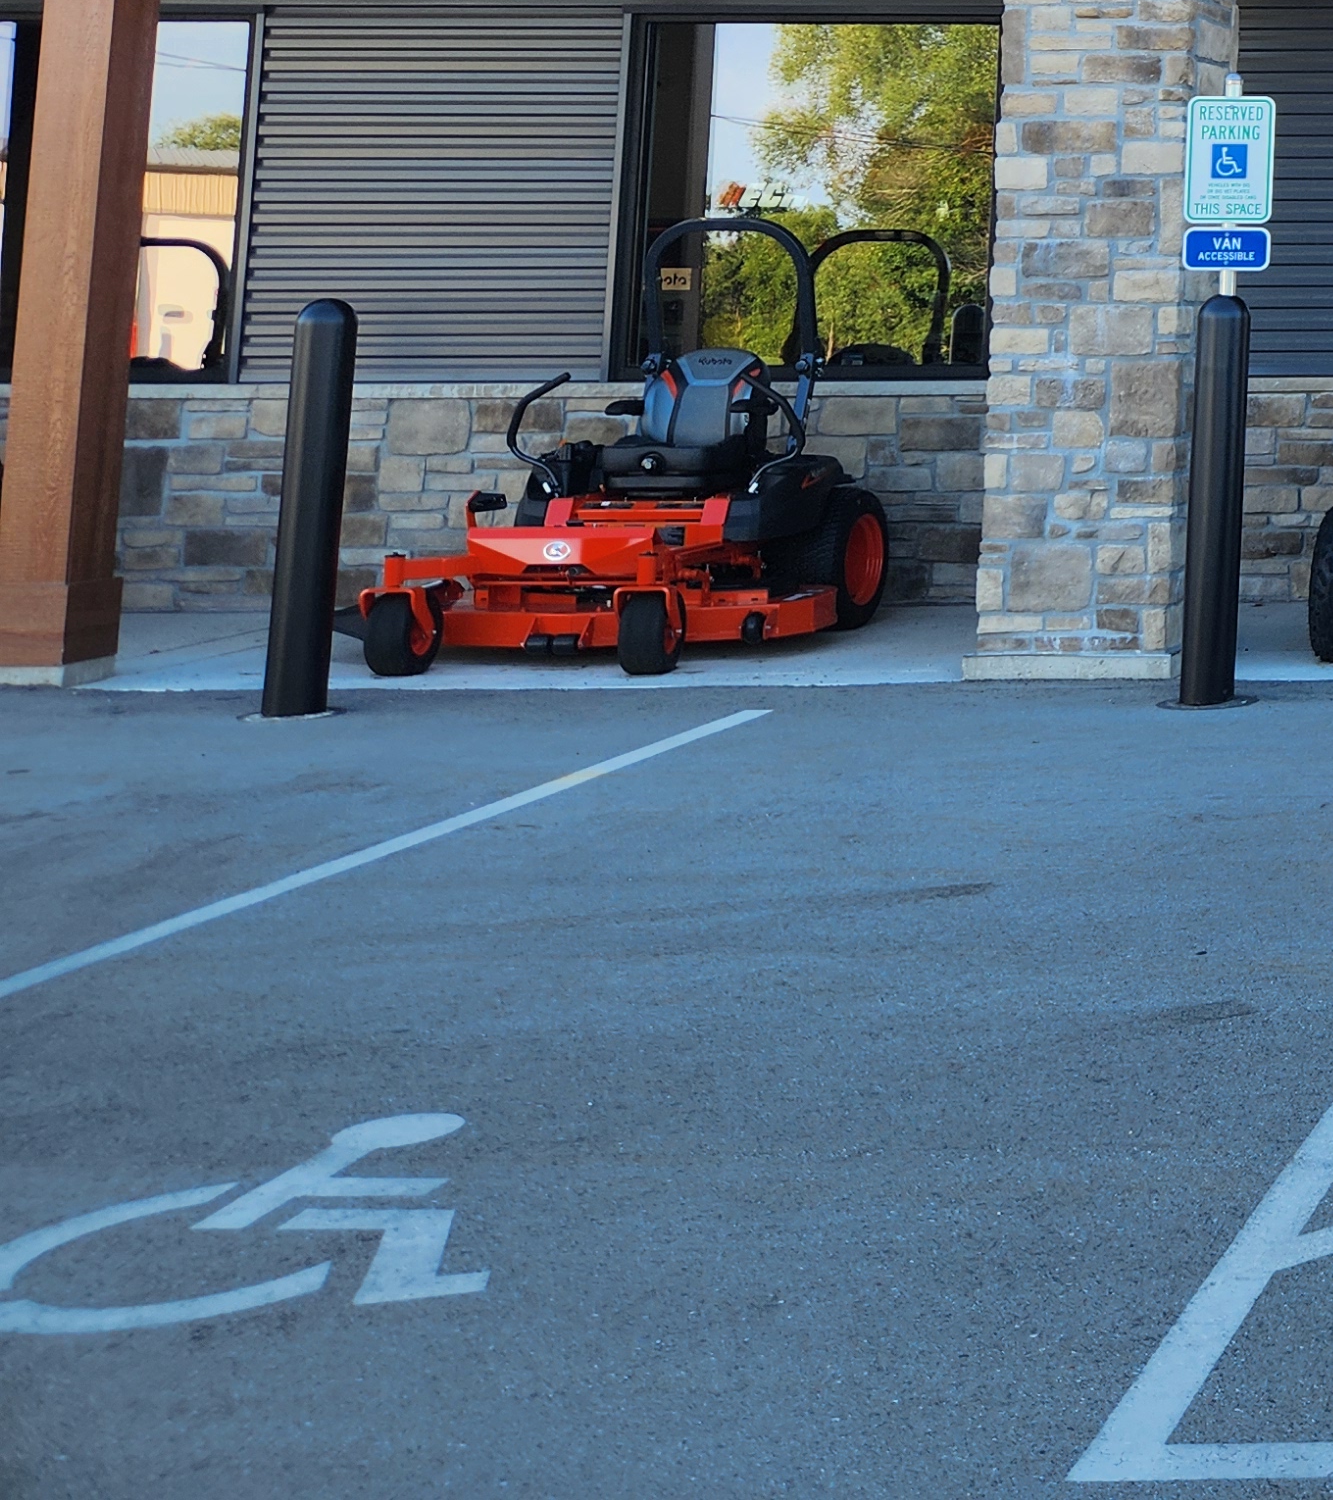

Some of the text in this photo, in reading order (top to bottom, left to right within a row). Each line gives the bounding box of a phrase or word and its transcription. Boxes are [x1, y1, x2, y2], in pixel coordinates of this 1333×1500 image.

[1200, 105, 1264, 121] RESERVED
[1201, 125, 1261, 141] PARKING
[1194, 203, 1262, 215] THIS SPACE
[1213, 236, 1242, 250] VAN
[1197, 251, 1256, 262] ACCESSIBLE
[662, 273, 688, 286] ota
[698, 356, 733, 366] Kubota
